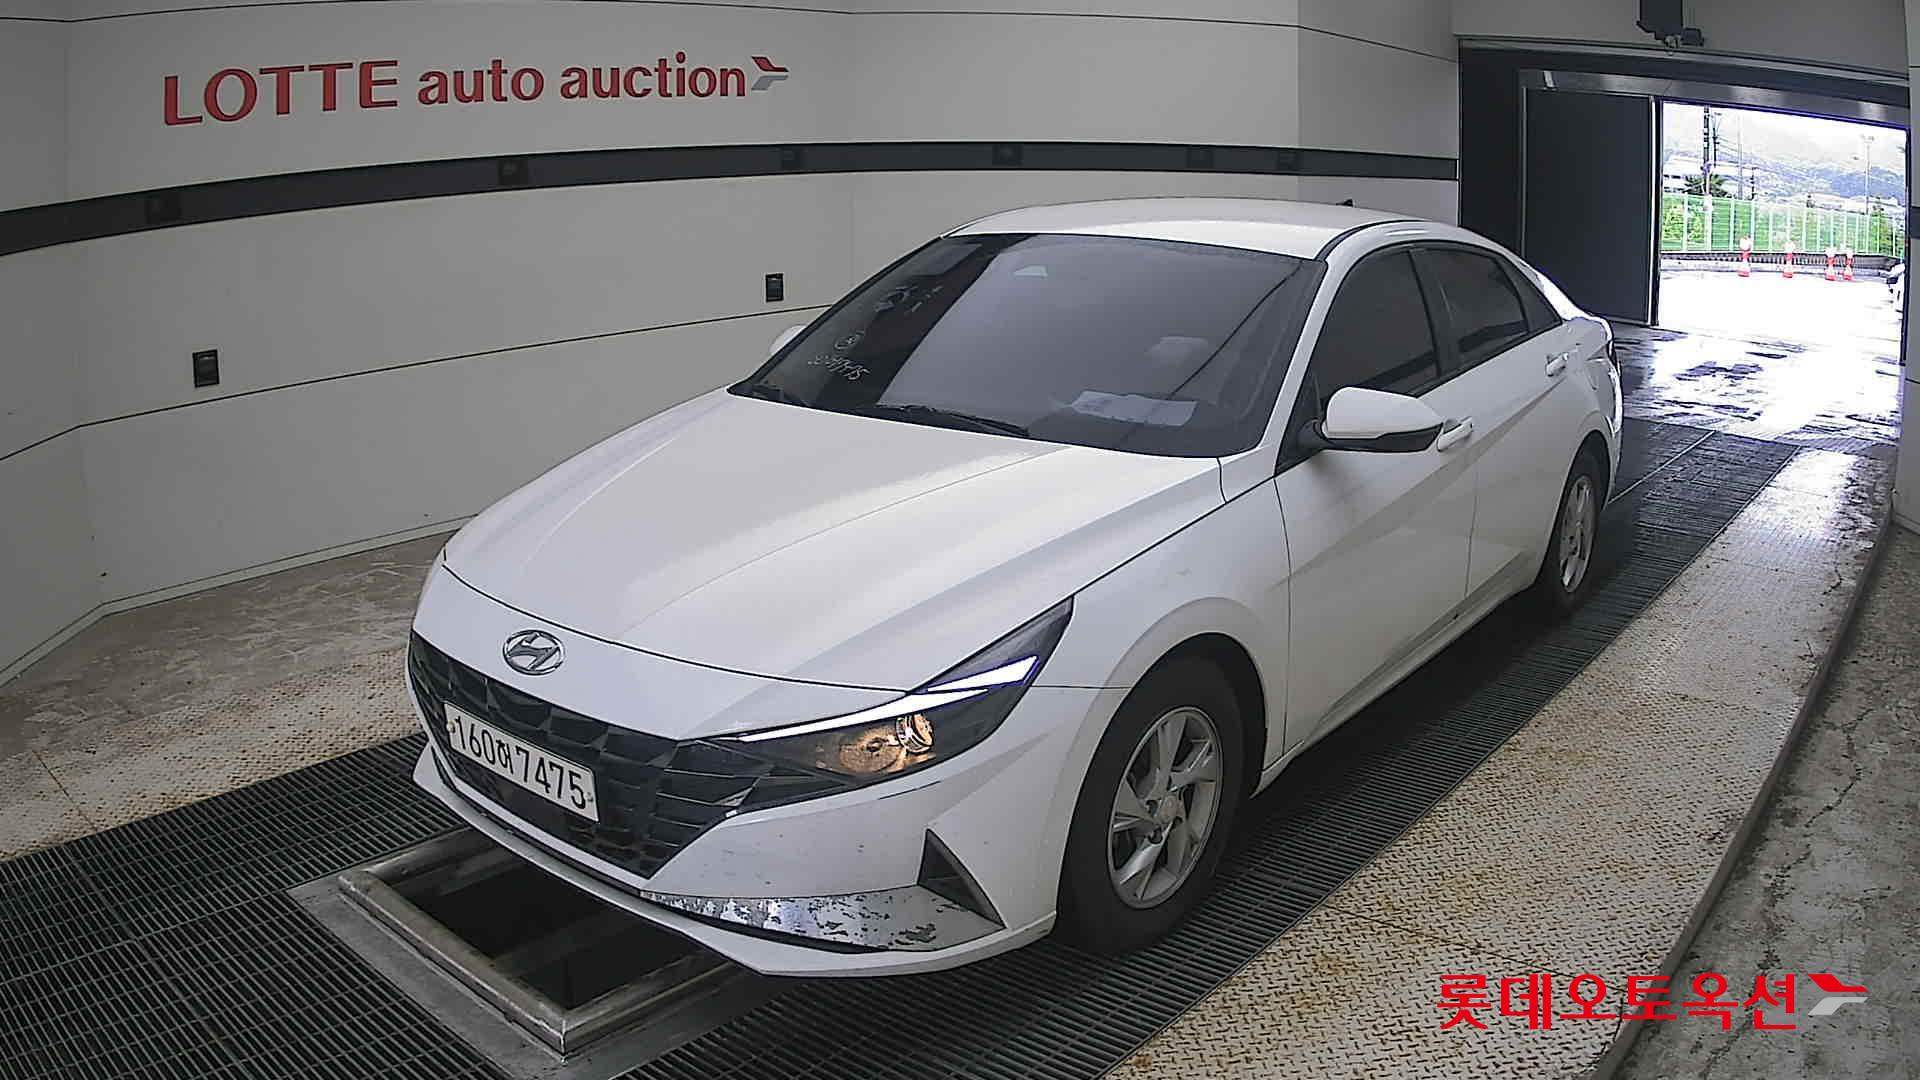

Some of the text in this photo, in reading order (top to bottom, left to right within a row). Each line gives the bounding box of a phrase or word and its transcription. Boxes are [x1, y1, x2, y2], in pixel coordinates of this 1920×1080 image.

[163, 51, 748, 127] LOTTE auto auction
